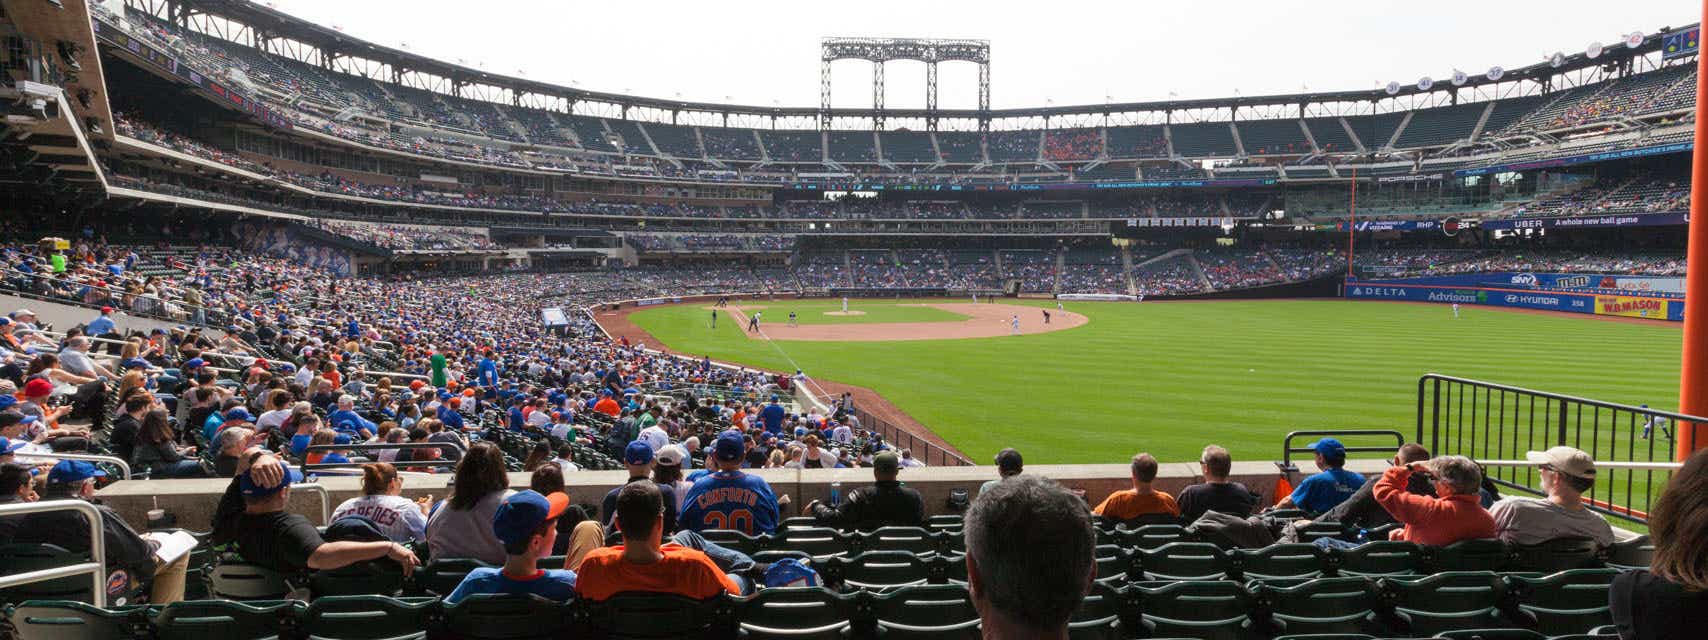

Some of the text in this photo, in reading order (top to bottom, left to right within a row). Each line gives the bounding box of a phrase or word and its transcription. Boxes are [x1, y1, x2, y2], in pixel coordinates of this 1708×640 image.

[1378, 173, 1444, 182] PORSCHE
[1514, 220, 1543, 228] UBER
[1616, 217, 1639, 225] game
[1511, 275, 1532, 284] SNY
[1365, 287, 1406, 297] DELTA
[1428, 292, 1476, 303] Advisors
[1520, 295, 1559, 306] HYUNDAI
[697, 486, 758, 509] CONFORTO
[328, 504, 400, 527] PEDES
